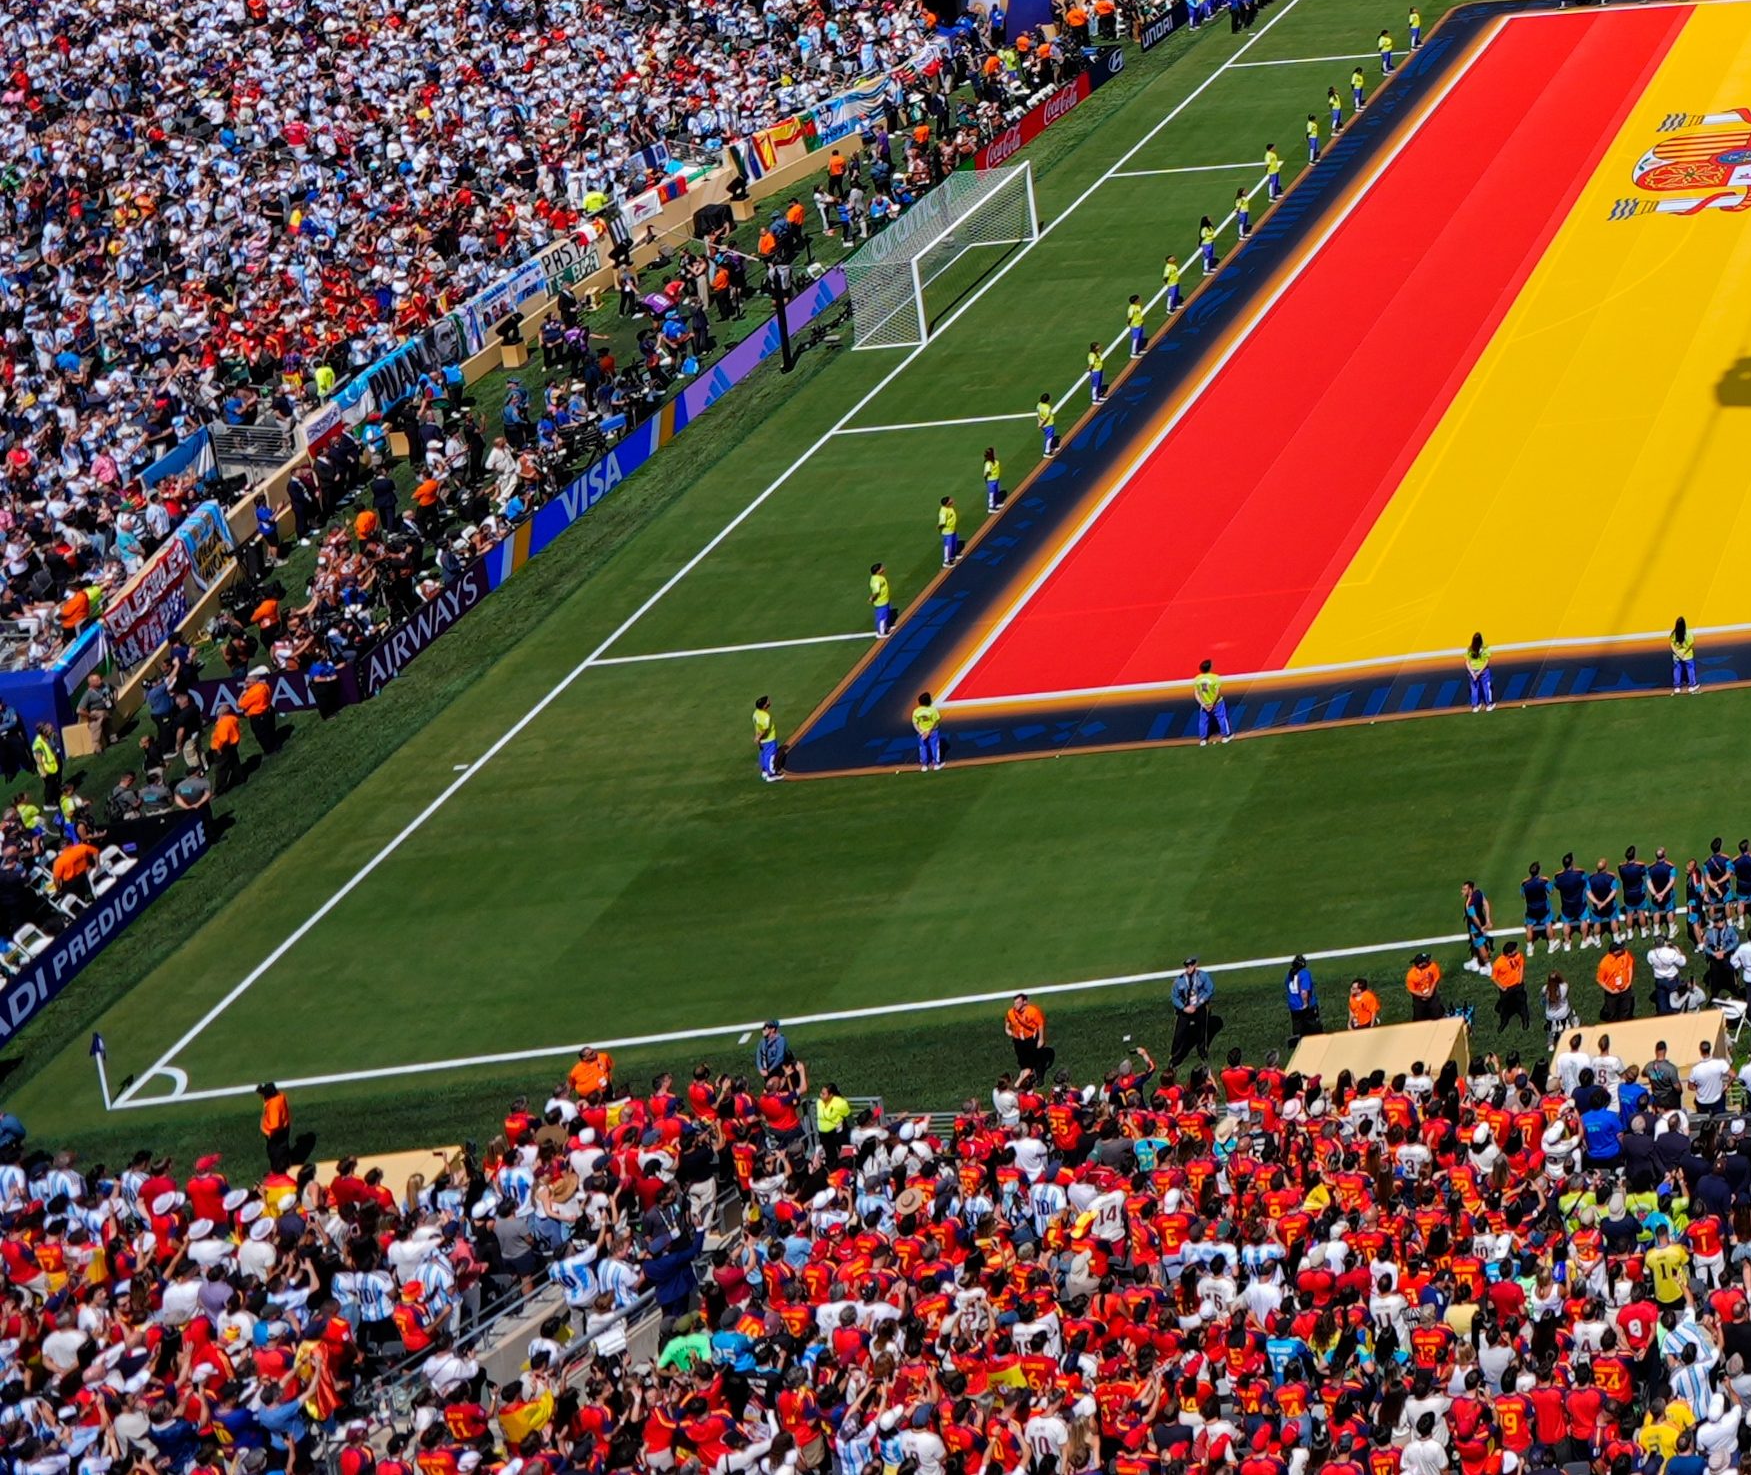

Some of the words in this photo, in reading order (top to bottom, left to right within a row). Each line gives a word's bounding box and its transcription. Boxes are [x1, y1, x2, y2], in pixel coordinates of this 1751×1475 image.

[1141, 13, 1174, 49] UNDAI
[554, 450, 624, 523] VISA
[367, 570, 477, 693] AIRWAYS
[1404, 1158, 1417, 1175] 3
[1097, 1206, 1117, 1226] 14
[1659, 1262, 1668, 1280] 1
[806, 1276, 819, 1295] 7
[1595, 1371, 1623, 1391] 24
[1498, 1411, 1519, 1435] 19
[1029, 1435, 1051, 1456] 10
